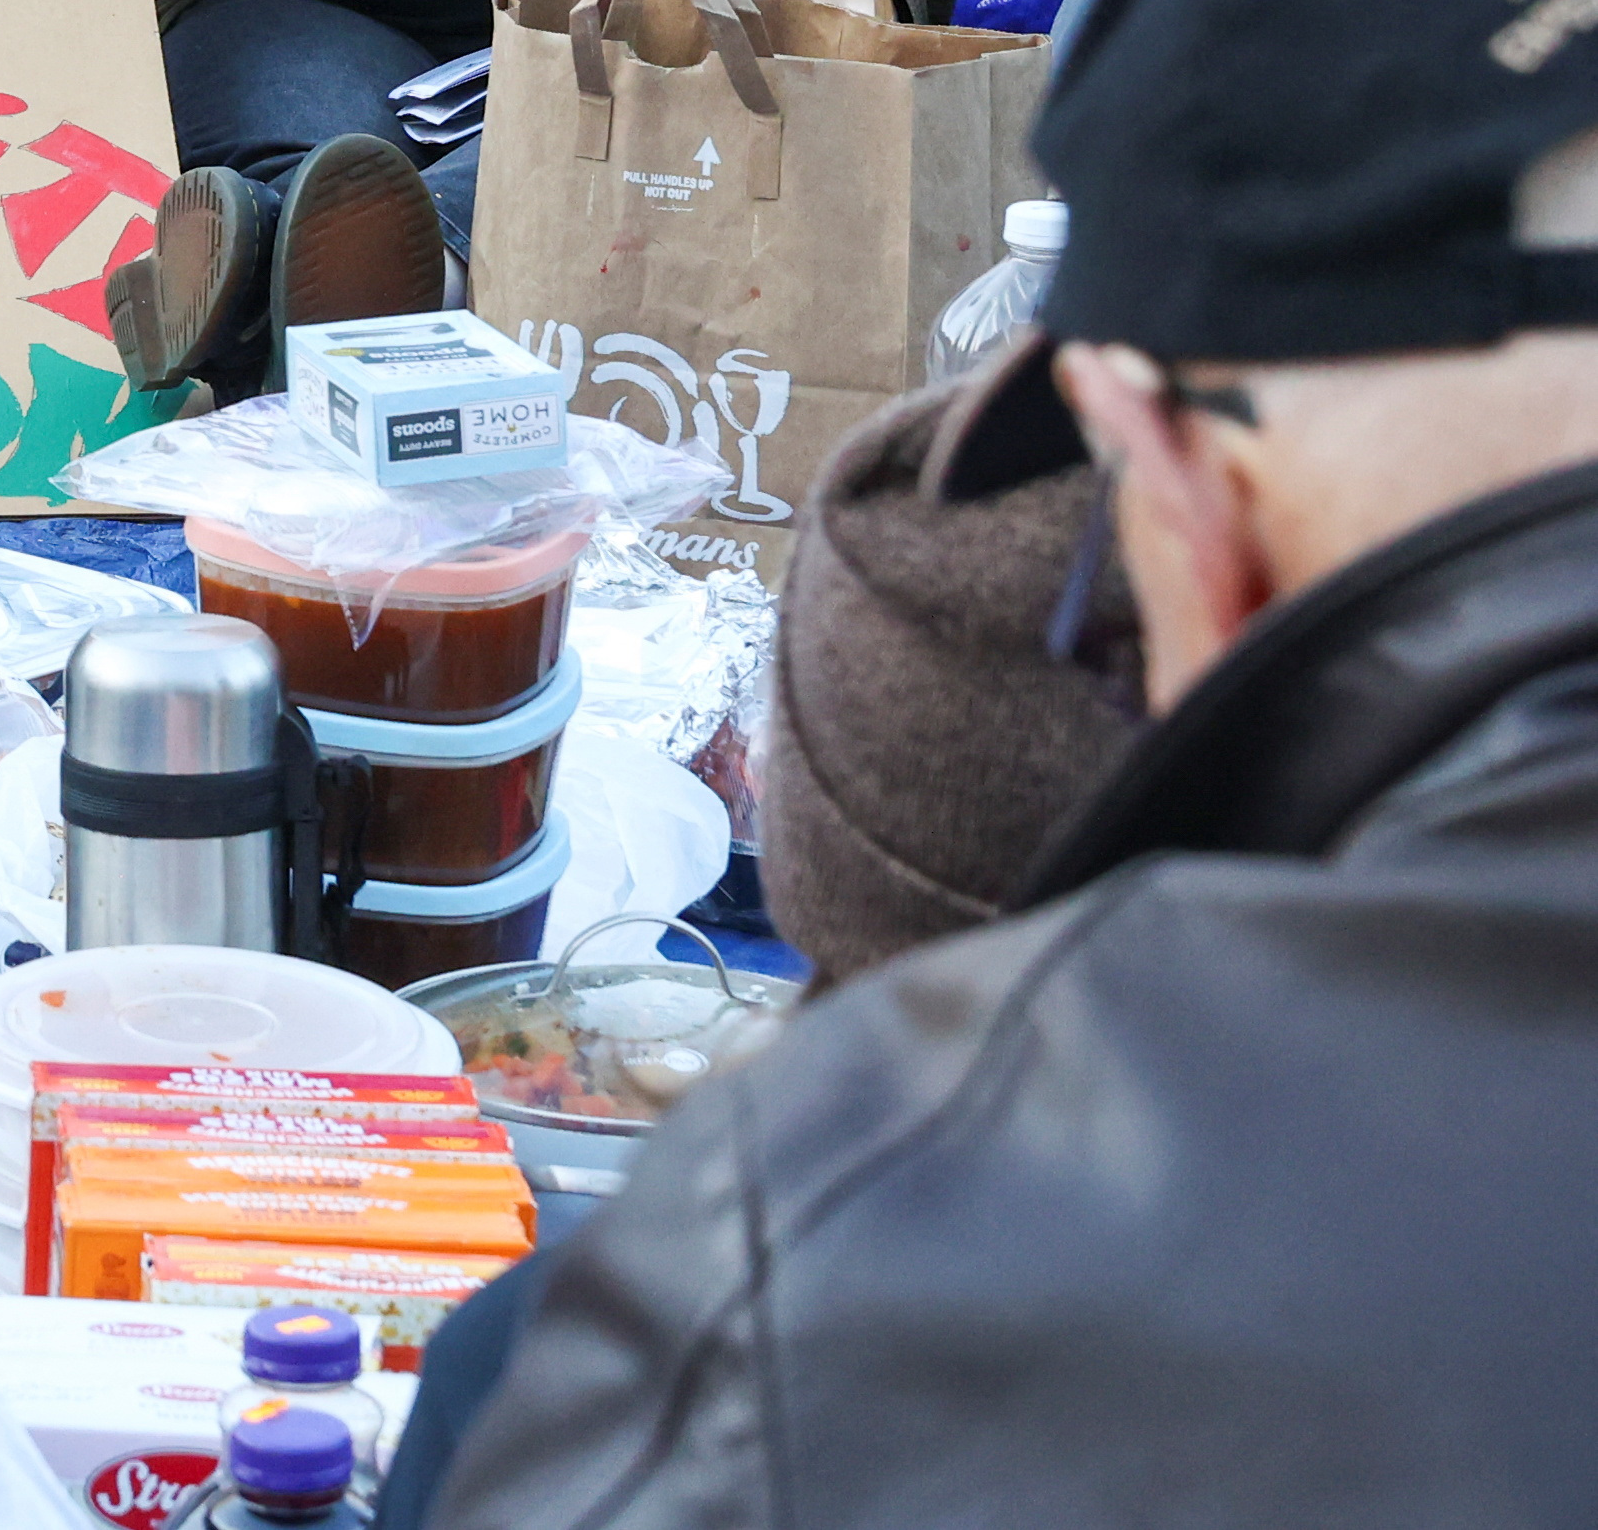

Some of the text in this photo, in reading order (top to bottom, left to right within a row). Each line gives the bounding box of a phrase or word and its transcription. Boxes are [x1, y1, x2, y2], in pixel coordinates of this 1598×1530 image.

[623, 170, 714, 191] PULL HANDLES UP
[644, 186, 691, 201] NOT OUT
[473, 401, 550, 427] HOME
[392, 415, 455, 438] spoons
[473, 425, 551, 447] COMPLETE
